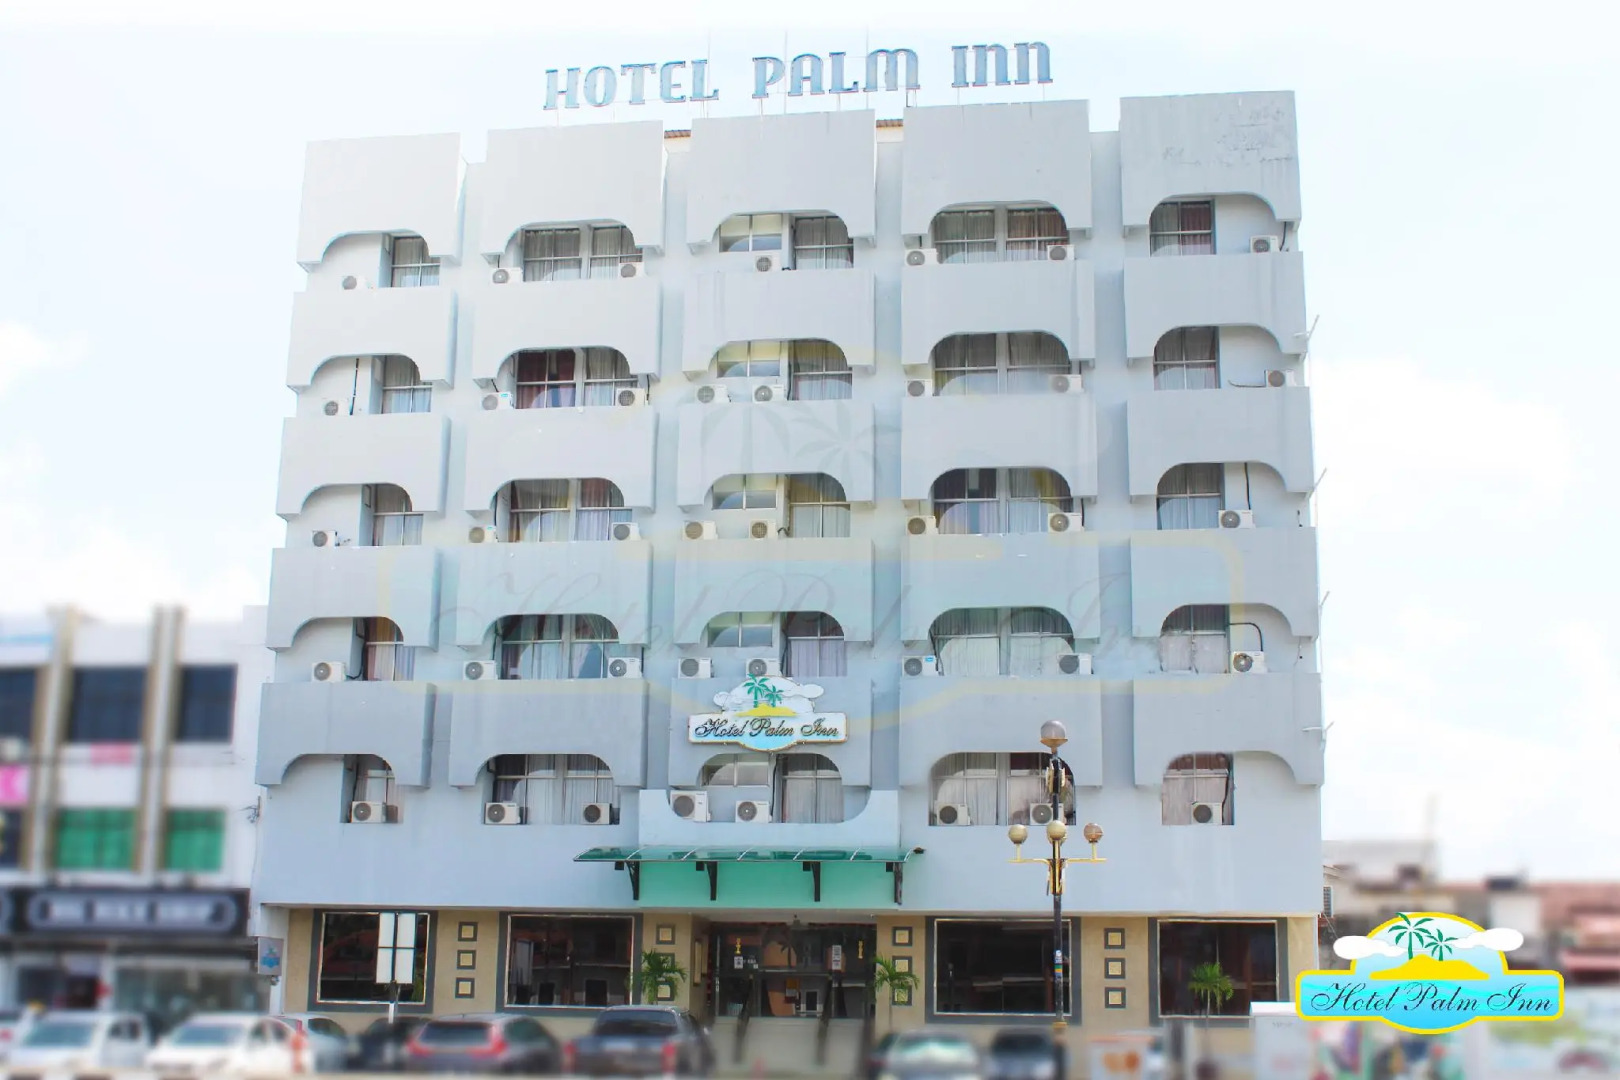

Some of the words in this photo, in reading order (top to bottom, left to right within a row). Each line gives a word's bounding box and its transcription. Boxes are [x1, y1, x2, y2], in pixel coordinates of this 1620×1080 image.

[543, 59, 719, 110] HOTEL
[694, 718, 749, 738] Hotel
[749, 717, 794, 738] Palm
[800, 718, 839, 738] Inn
